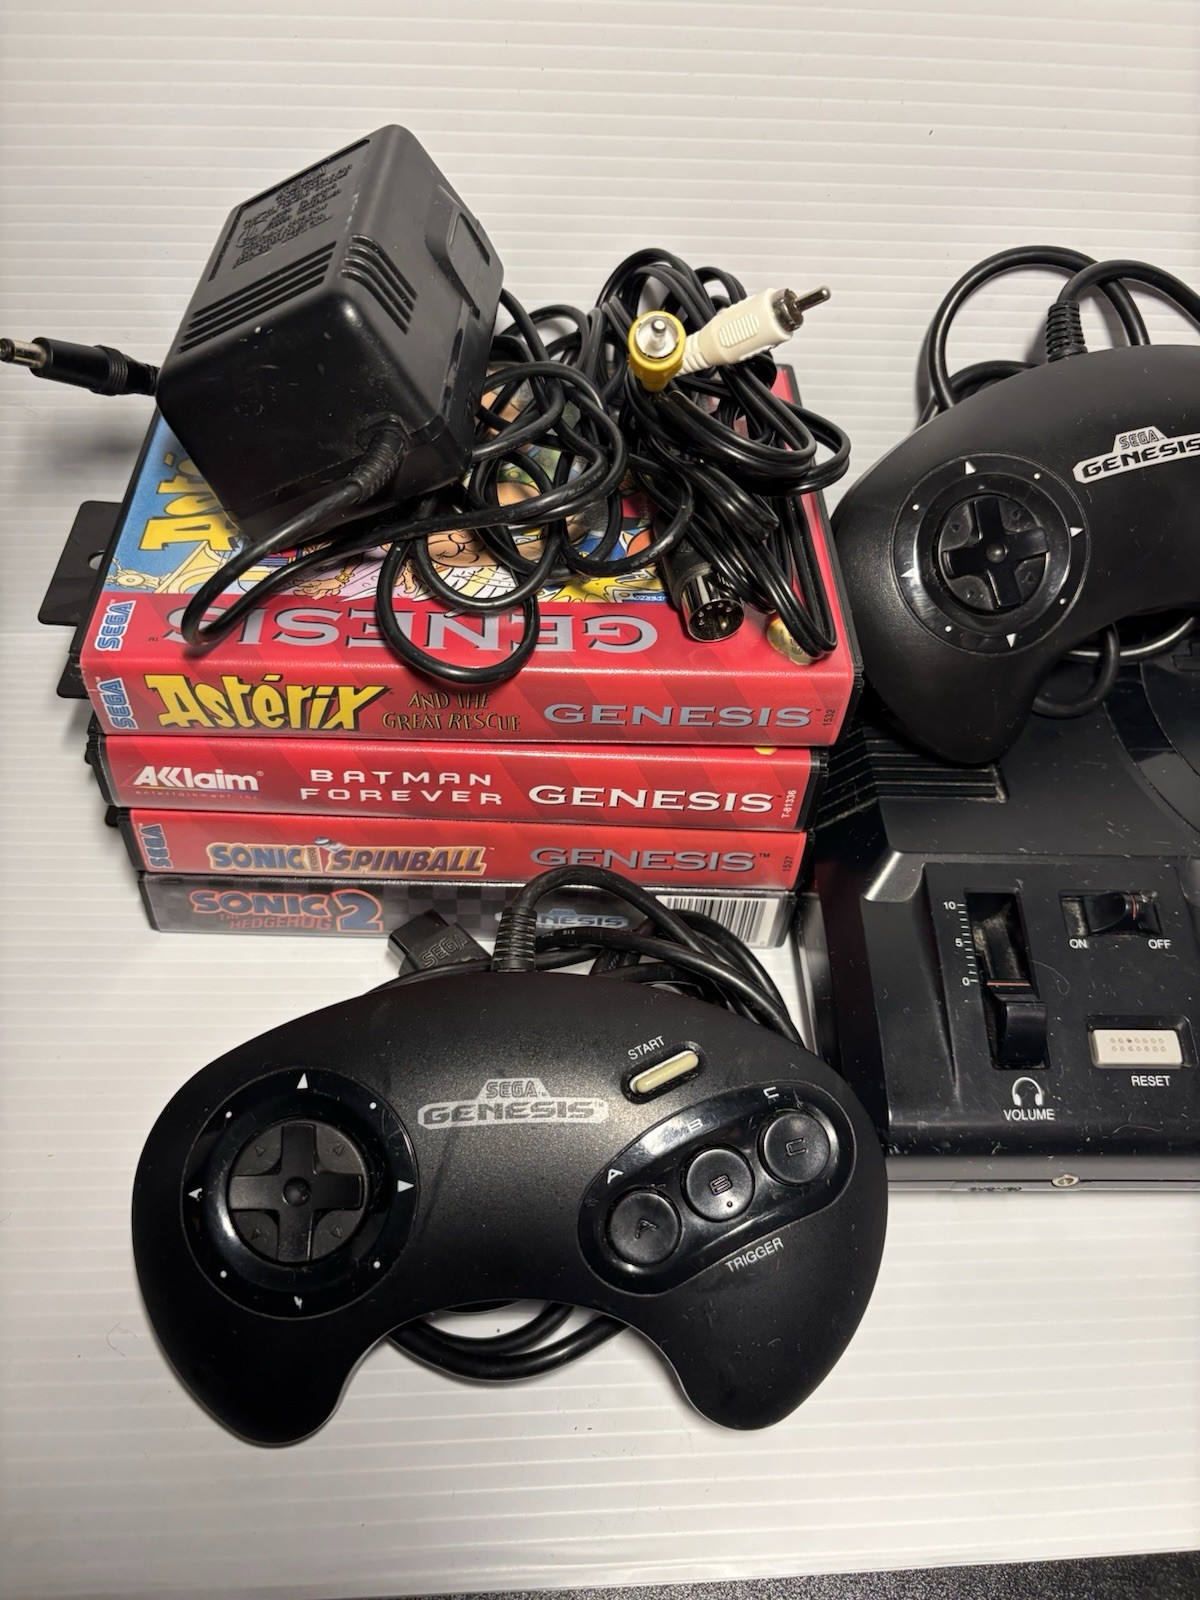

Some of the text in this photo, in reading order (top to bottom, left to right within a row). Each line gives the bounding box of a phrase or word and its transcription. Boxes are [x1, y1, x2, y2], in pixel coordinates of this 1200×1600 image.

[1119, 429, 1160, 450] SEGA
[1082, 438, 1200, 479] GENESIS
[96, 601, 136, 650] SEGA
[98, 678, 138, 729] SEGA
[408, 691, 491, 710] AND THE
[382, 711, 521, 731] GREAT RESCUE
[543, 703, 812, 728] GENESIS
[823, 709, 835, 726] 1532
[310, 769, 492, 786] BATMAN
[301, 788, 502, 805] FOREVER
[529, 785, 773, 812] GENESIS
[781, 789, 797, 819] T-81336
[139, 823, 174, 868] SEGA
[207, 843, 307, 871] SONIC
[328, 847, 486, 874] SPINBALL
[530, 846, 757, 872] GENESIS
[190, 888, 385, 932] SONIC 2
[943, 901, 956, 910] 10
[537, 914, 625, 927] NESIS
[420, 934, 468, 969] SEGA
[955, 938, 963, 947] 5
[1069, 938, 1088, 949] ON
[1148, 938, 1171, 950] OFF
[962, 978, 970, 986] 0
[627, 1035, 666, 1061] START
[486, 1080, 538, 1099] SEGA
[1131, 1075, 1171, 1086] RESET
[423, 1101, 596, 1125] GENESIS
[1003, 1108, 1056, 1121] VOLUME
[607, 1169, 624, 1184] A
[724, 1236, 785, 1274] TRIGGER
